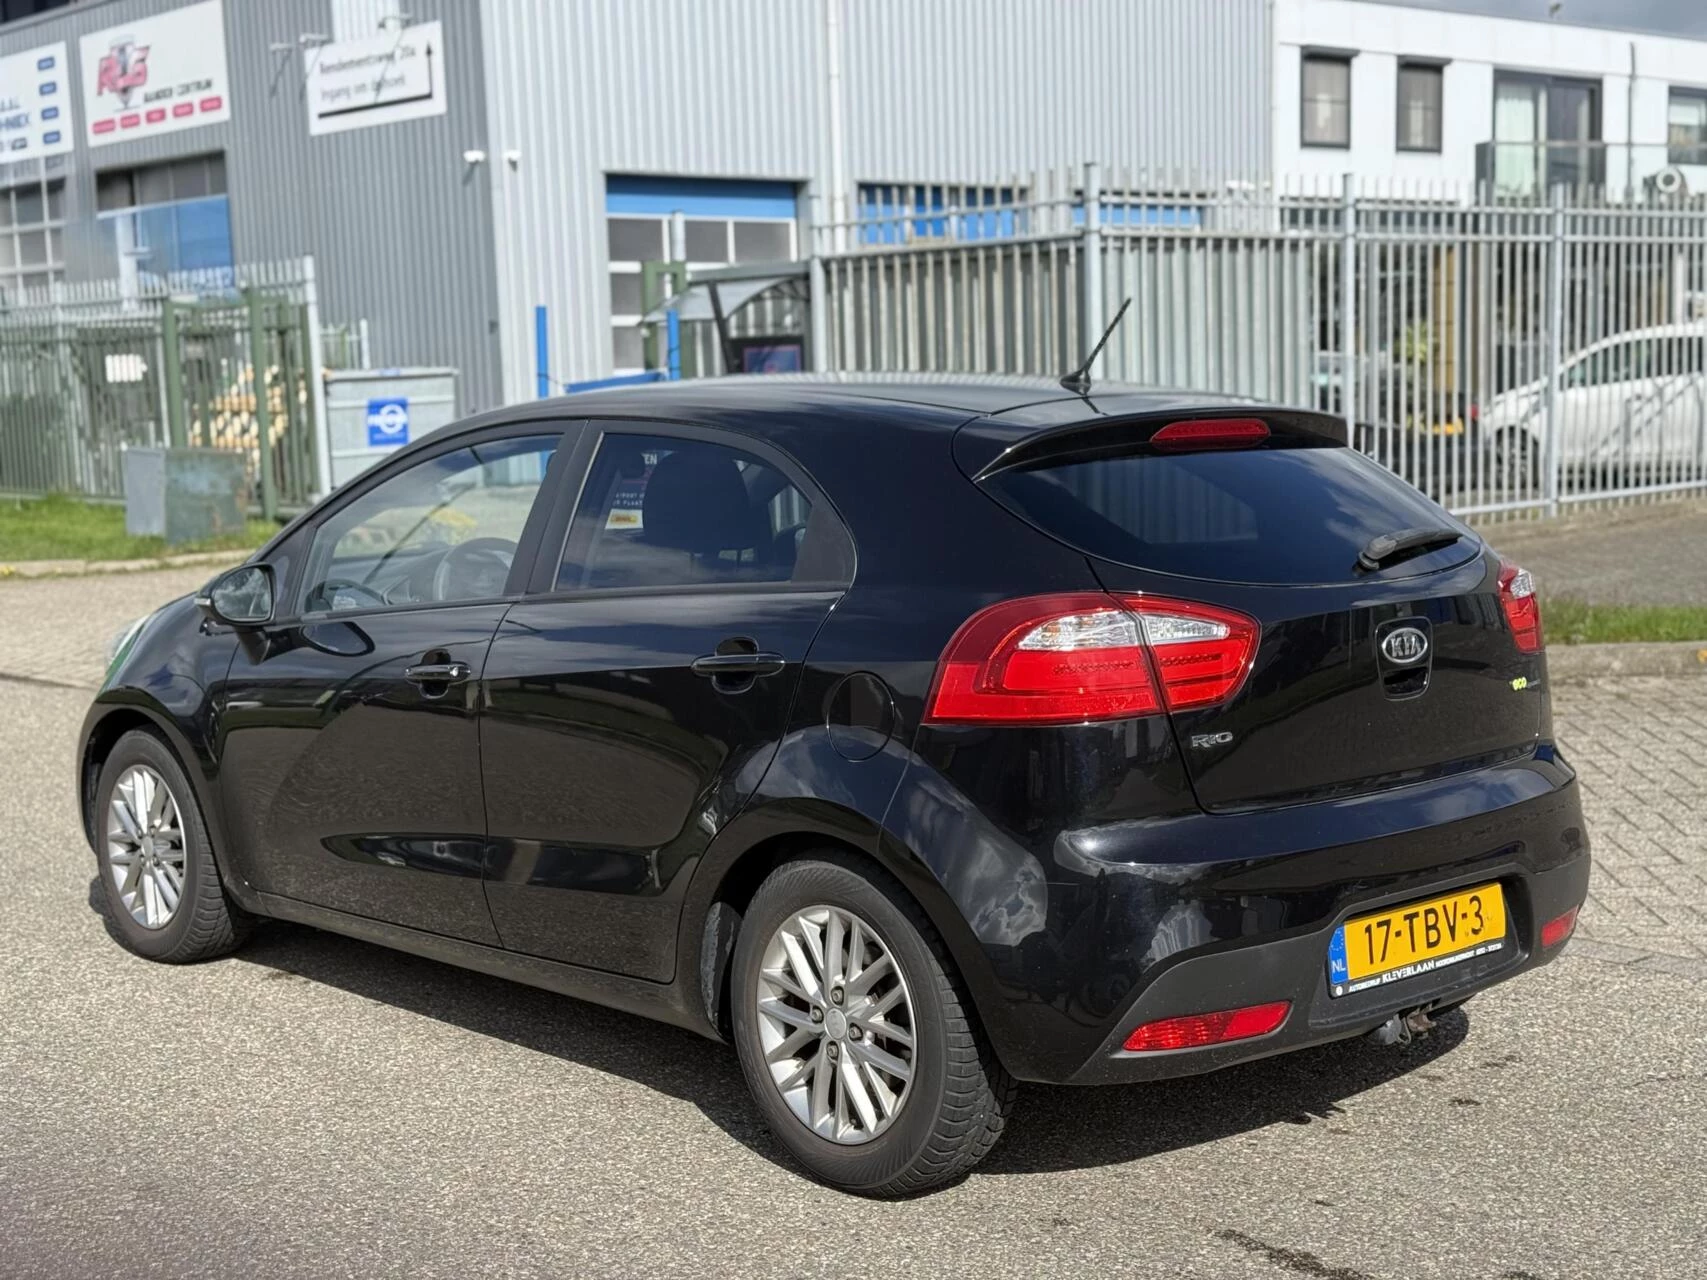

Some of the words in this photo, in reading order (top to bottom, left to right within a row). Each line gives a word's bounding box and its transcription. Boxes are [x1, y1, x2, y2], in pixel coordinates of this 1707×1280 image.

[1391, 634, 1422, 657] KIA
[1191, 731, 1233, 748] RIO
[1363, 895, 1484, 965] 17-TBV-3
[1332, 959, 1346, 974] NL
[1382, 960, 1435, 983] KLEVERLAAN
